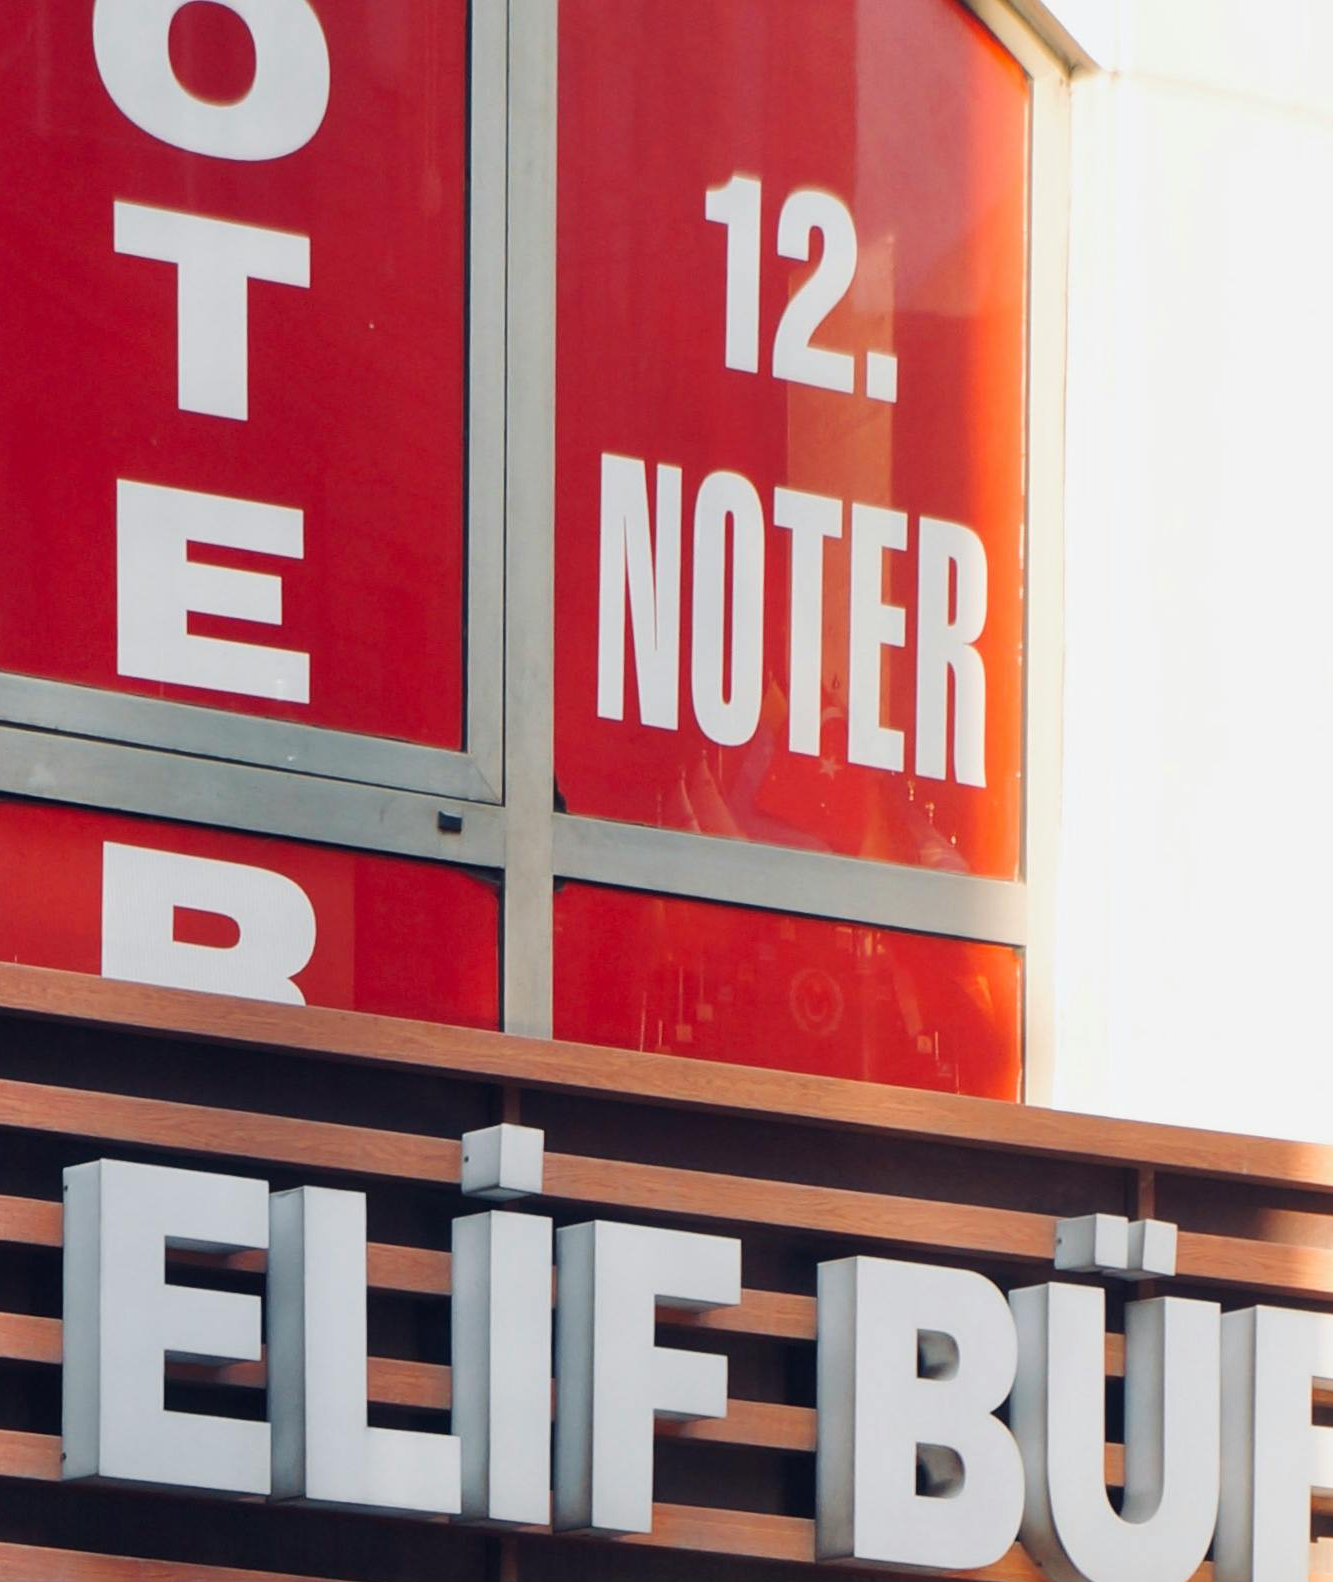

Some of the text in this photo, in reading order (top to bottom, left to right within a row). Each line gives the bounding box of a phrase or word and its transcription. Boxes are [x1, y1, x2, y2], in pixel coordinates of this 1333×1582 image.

[705, 173, 897, 403] 12.
[597, 452, 988, 788] NOTER
[62, 1123, 743, 1535] ELİF
